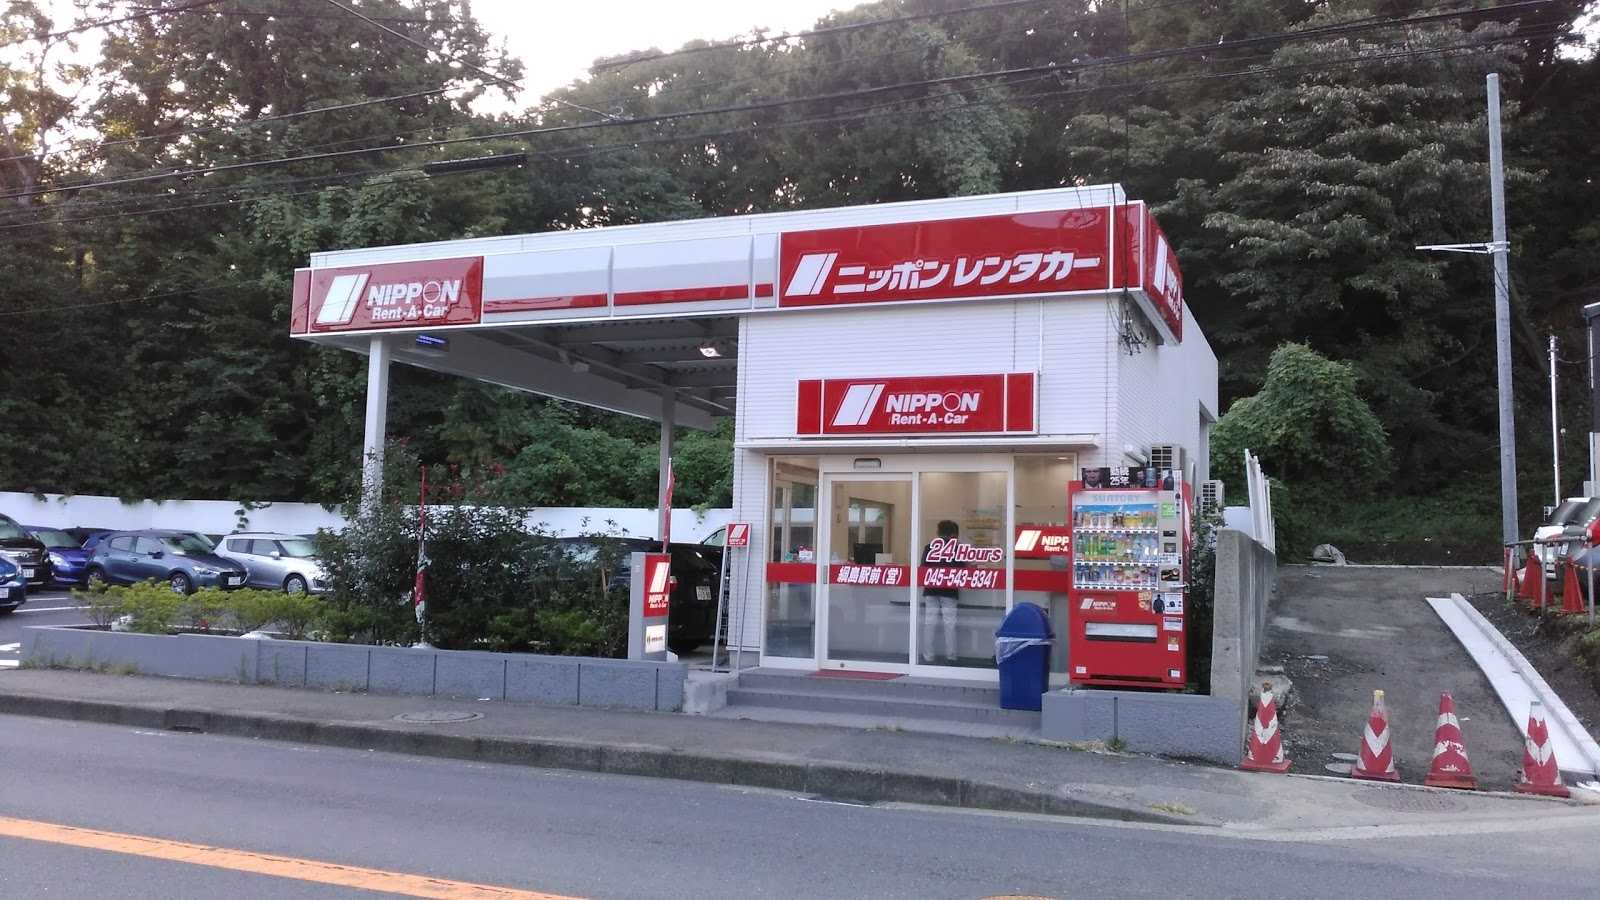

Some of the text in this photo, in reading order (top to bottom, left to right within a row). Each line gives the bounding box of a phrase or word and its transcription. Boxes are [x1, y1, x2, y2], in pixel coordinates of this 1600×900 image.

[367, 279, 461, 306] NIPPON
[372, 303, 448, 320] Rent-A-Car
[886, 392, 980, 412] NIPPON
[891, 412, 969, 424] Rent-A-Car
[923, 568, 999, 588] 045-543-8341
